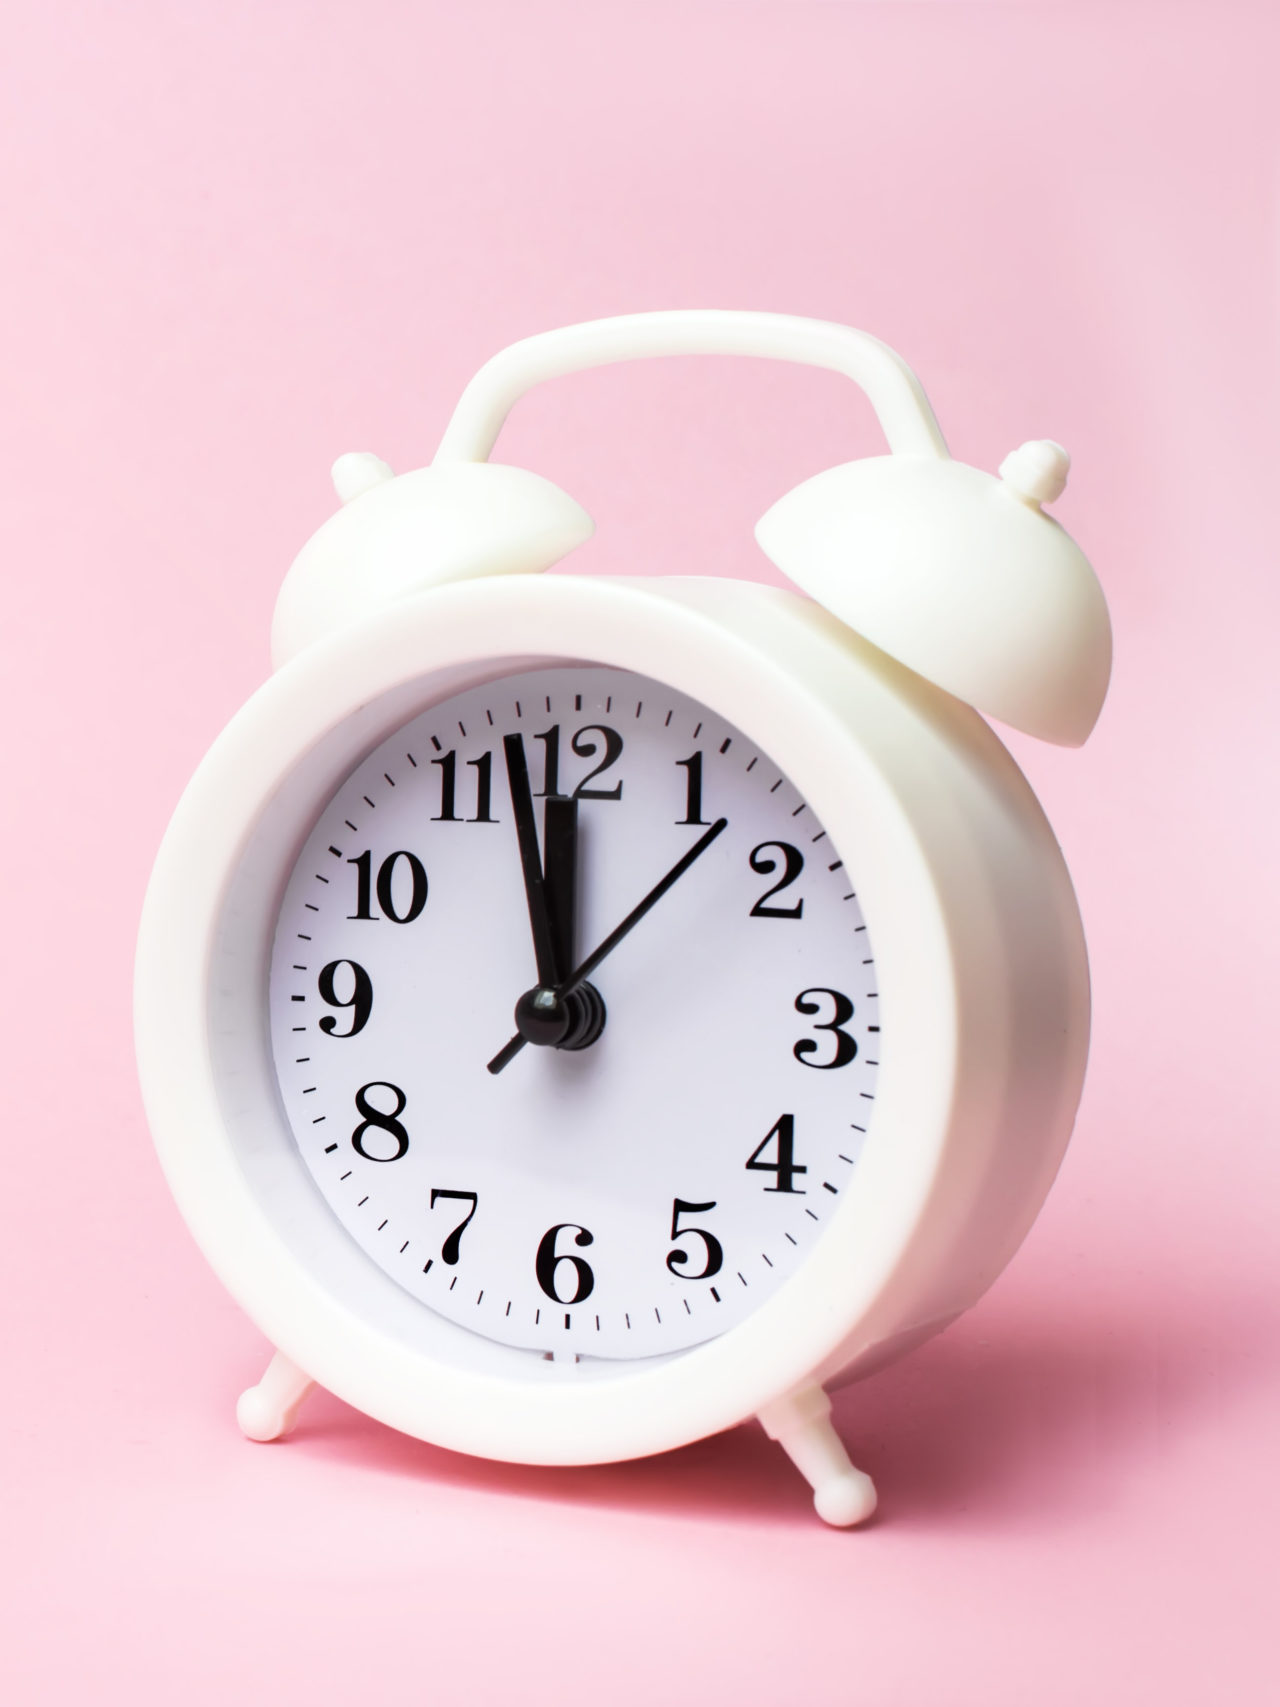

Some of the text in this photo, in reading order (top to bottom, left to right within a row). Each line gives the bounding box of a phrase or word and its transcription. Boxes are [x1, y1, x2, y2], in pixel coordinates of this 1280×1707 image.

[430, 749, 500, 824] 11
[533, 724, 623, 801] 12
[674, 750, 712, 825] 1
[346, 849, 429, 925] 10
[748, 841, 805, 920] 2
[317, 959, 374, 1039] 9
[793, 987, 858, 1070] 3
[351, 1081, 410, 1163] 8
[745, 1113, 807, 1195] 4
[430, 1188, 478, 1266] 7
[535, 1223, 595, 1305] 6
[666, 1197, 724, 1280] 5
